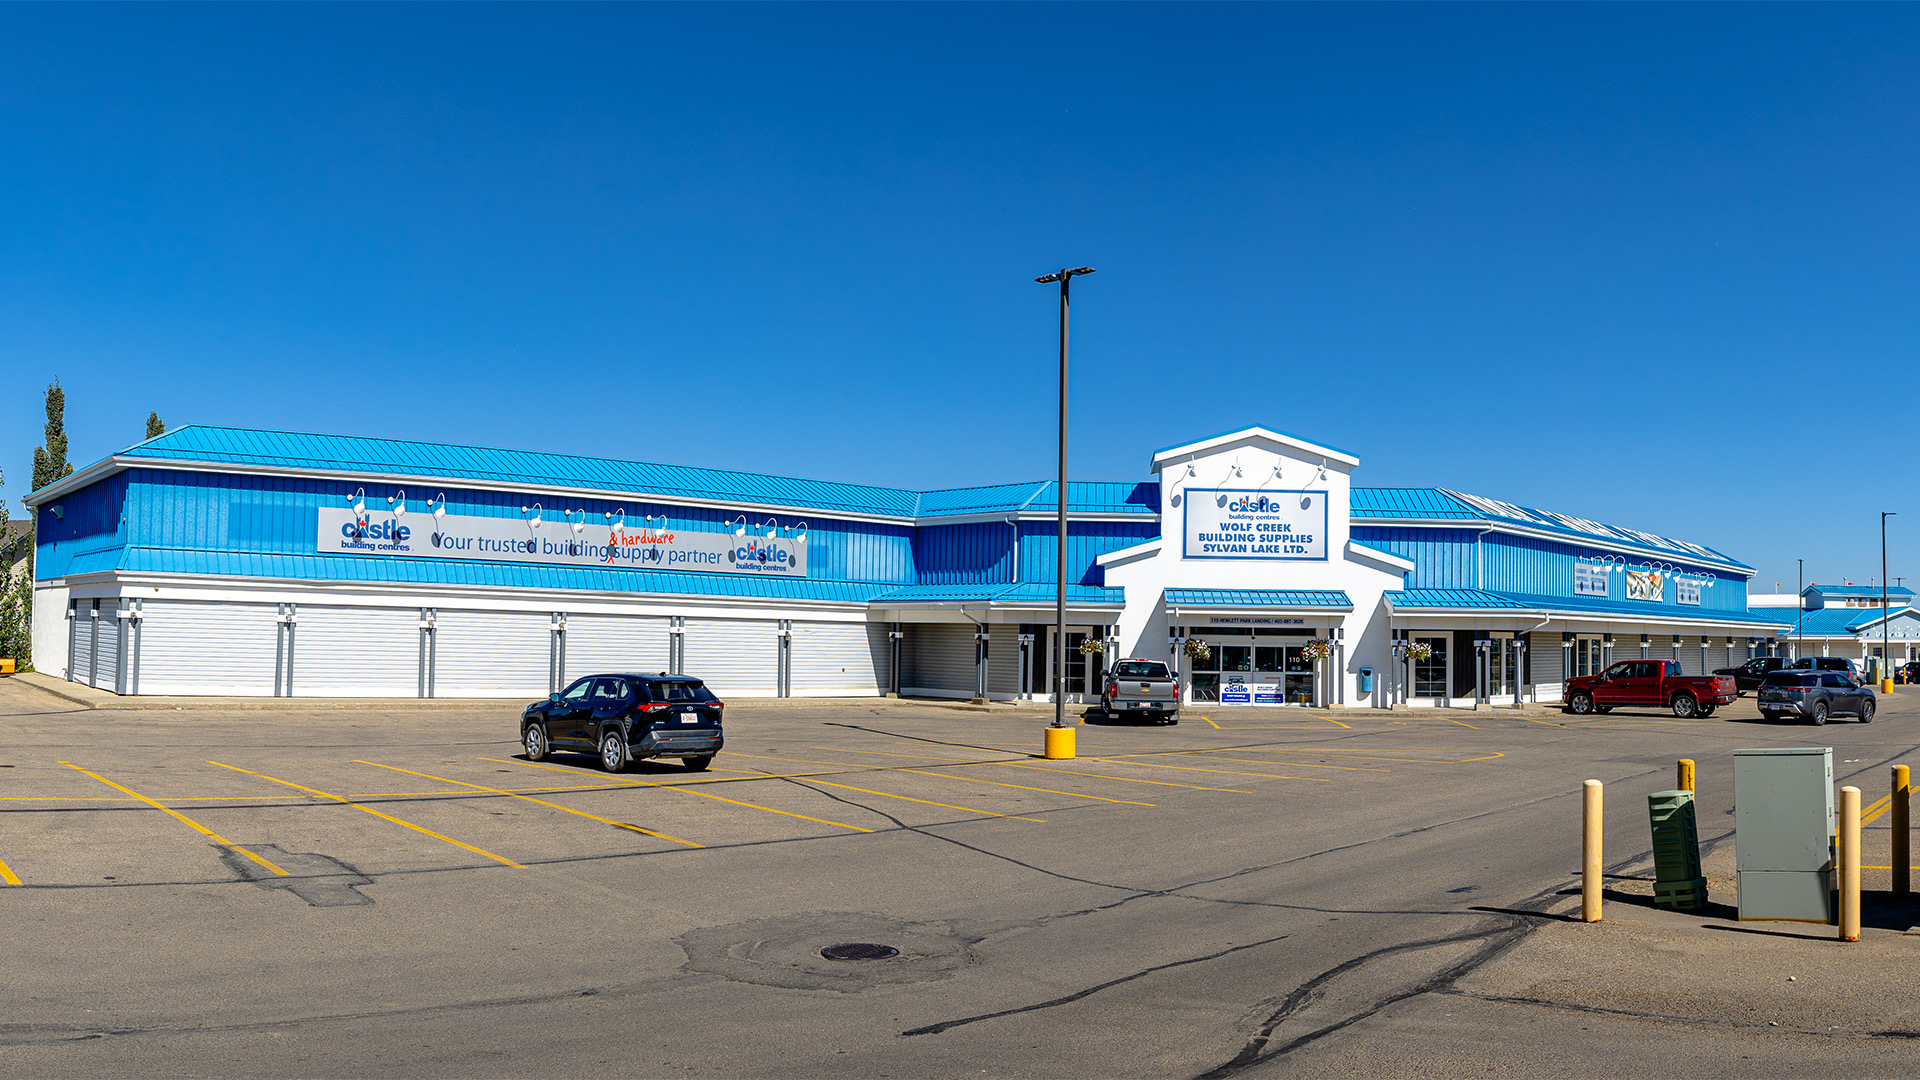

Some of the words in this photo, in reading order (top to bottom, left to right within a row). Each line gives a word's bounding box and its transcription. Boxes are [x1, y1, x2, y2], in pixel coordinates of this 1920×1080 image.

[1229, 495, 1280, 513] castle
[341, 514, 411, 542] castle
[1220, 523, 1252, 532] WOLF
[1256, 523, 1291, 533] CREEK
[609, 531, 618, 546] &
[622, 529, 674, 546] hardware
[1199, 533, 1255, 542] BUILDING
[1259, 534, 1313, 543] SUPPLIES
[341, 540, 376, 551] building
[378, 543, 410, 552] centres
[434, 531, 473, 549] Your
[478, 535, 537, 554] trusted
[543, 537, 608, 562] building
[614, 545, 664, 565] supply
[669, 550, 722, 567] partner
[736, 540, 787, 563] castle
[1203, 544, 1247, 553] SYLVAN
[1251, 544, 1280, 553] LAKE
[1284, 545, 1308, 554] LTD.
[736, 562, 762, 572] building
